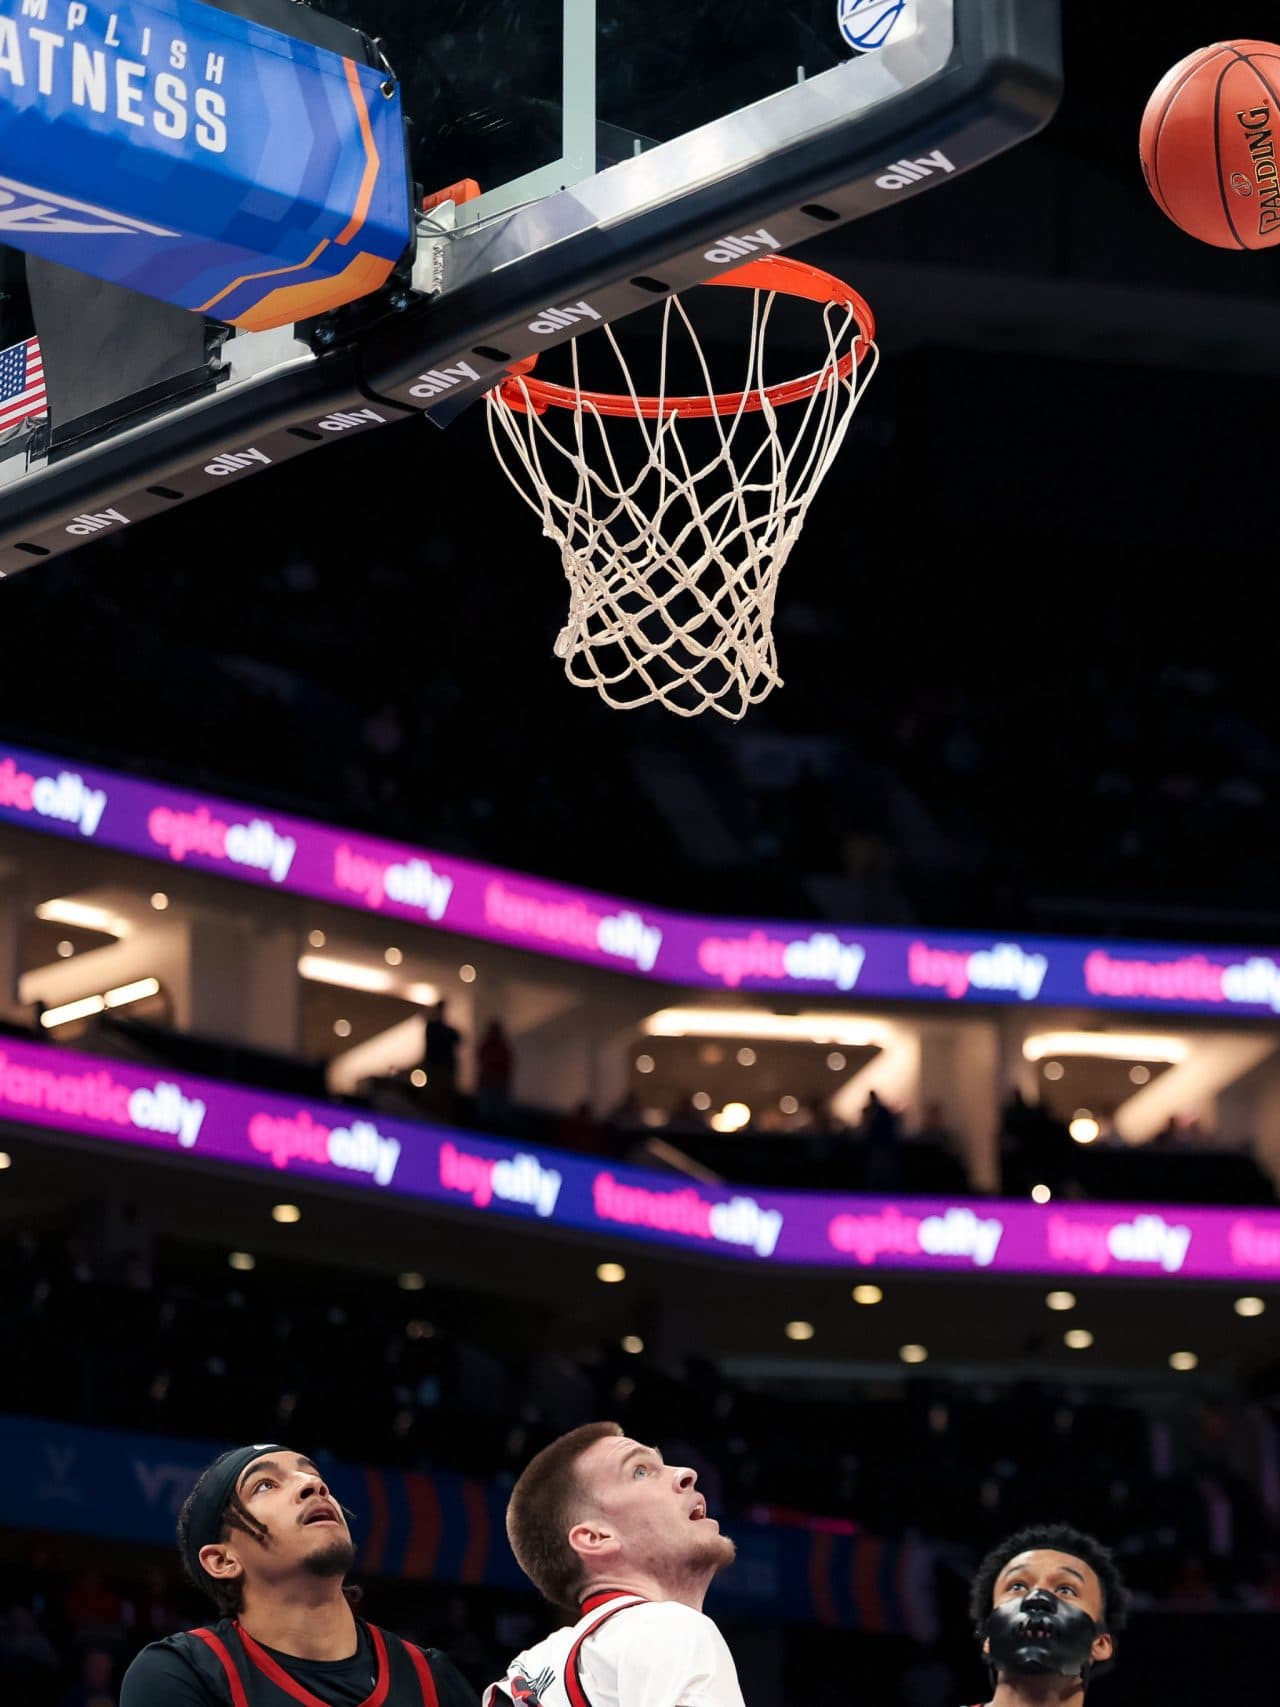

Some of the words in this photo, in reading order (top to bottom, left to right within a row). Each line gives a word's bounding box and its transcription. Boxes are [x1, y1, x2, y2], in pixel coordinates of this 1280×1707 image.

[0, 14, 227, 154] ATNESS
[874, 149, 956, 190] ally
[704, 228, 782, 264] ally
[528, 300, 602, 334] ally
[408, 360, 481, 399] ally
[318, 407, 387, 432] ally
[204, 446, 272, 476] ally
[65, 508, 131, 535] ally
